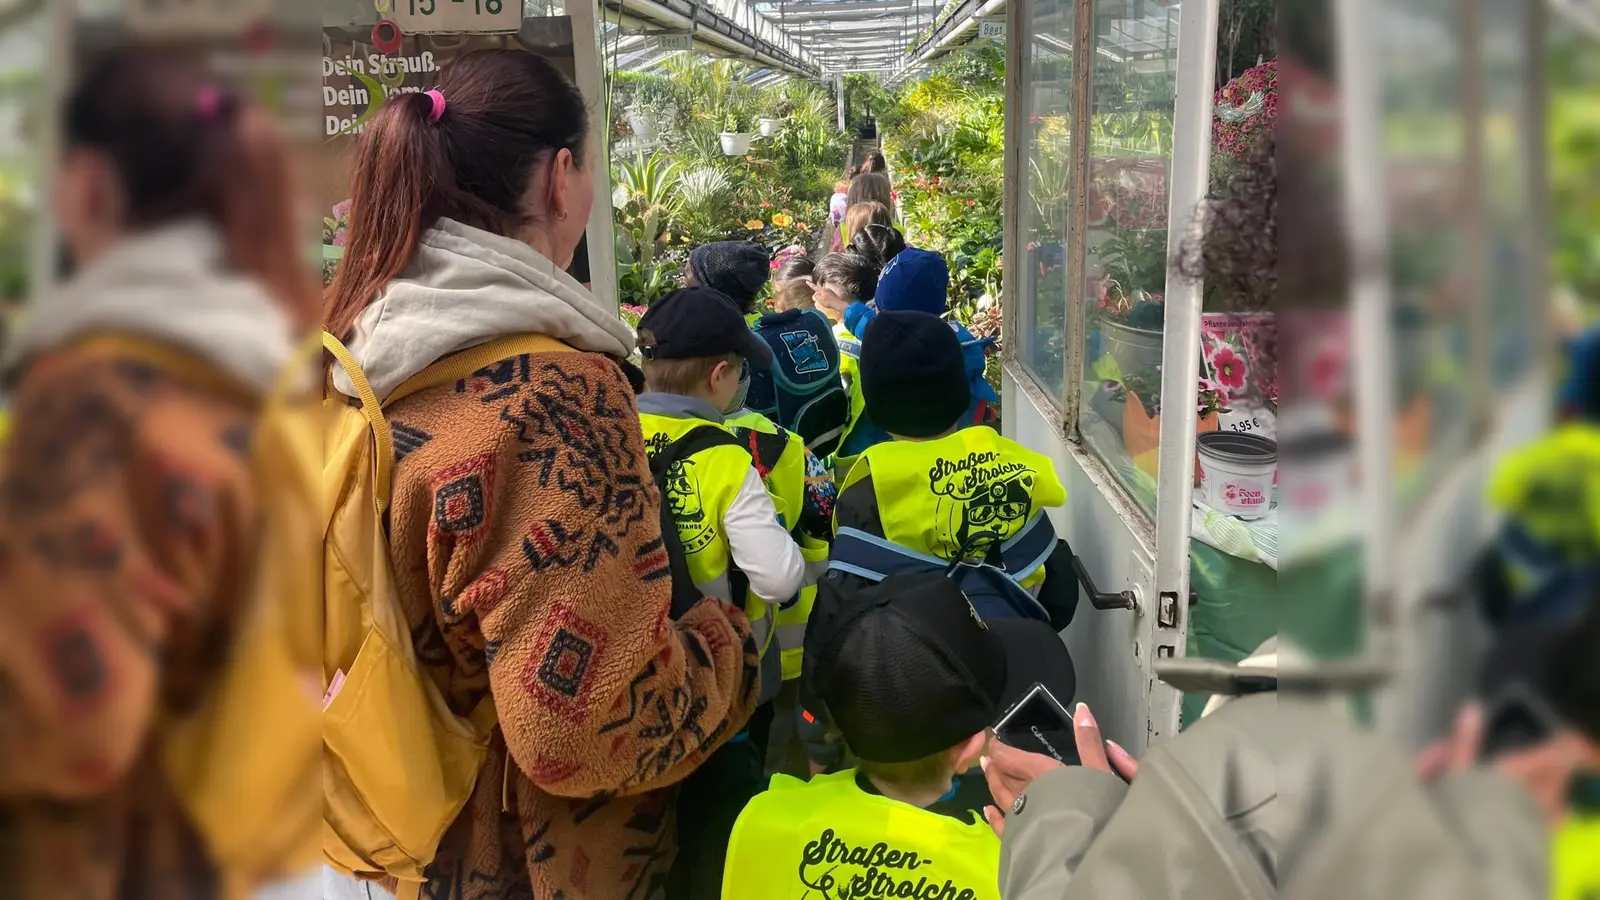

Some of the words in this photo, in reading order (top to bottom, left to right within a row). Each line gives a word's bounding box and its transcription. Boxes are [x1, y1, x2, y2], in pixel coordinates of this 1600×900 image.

[322, 55, 365, 77] Dein
[368, 51, 441, 75] Strauß.
[322, 85, 369, 107] Dein
[929, 451, 1001, 483] Straßen-
[965, 462, 1027, 489] Strolche
[802, 828, 932, 870] Straßen-
[851, 866, 977, 900] Strolche
